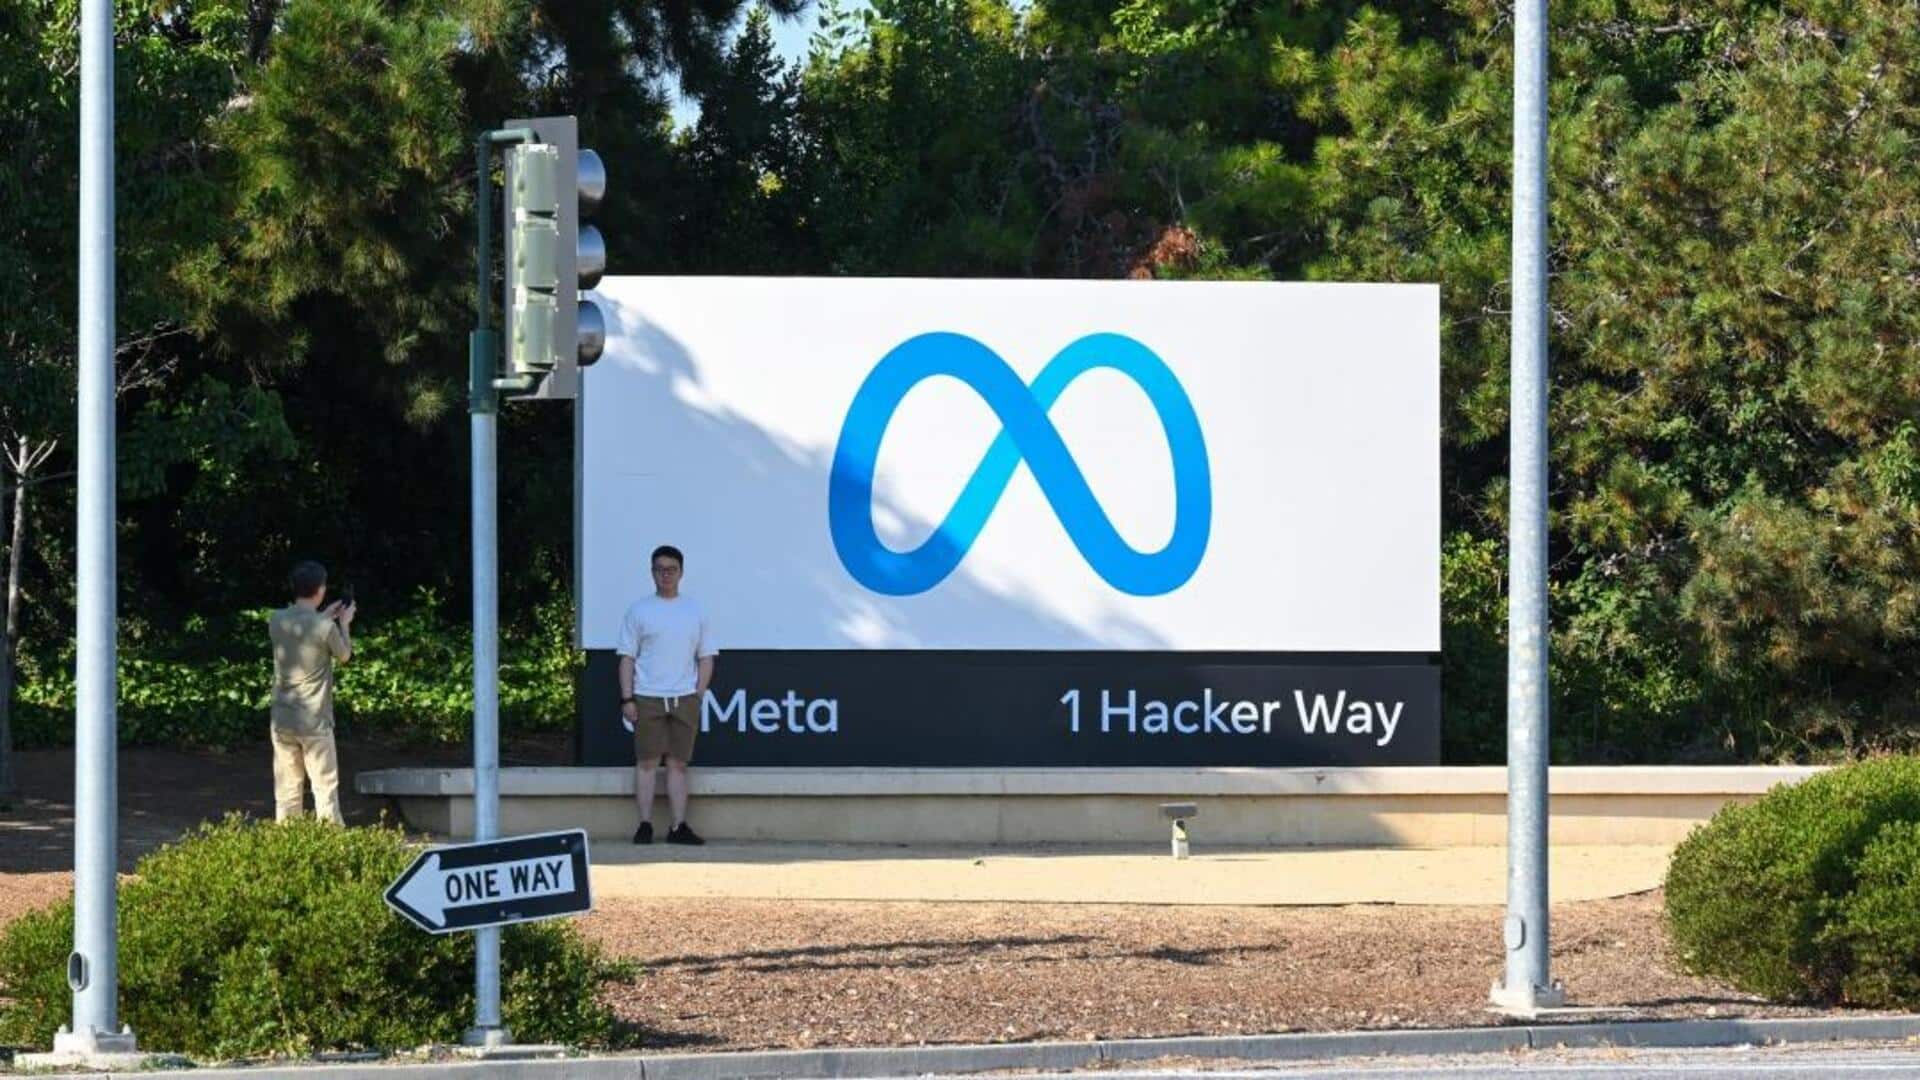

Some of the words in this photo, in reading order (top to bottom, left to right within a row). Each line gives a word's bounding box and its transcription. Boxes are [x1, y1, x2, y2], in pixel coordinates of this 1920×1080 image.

[700, 688, 838, 733] Meta
[1059, 689, 1080, 732] 1
[1101, 688, 1280, 734] Hacker
[1293, 689, 1405, 746] Way
[445, 869, 501, 902] ONE
[510, 860, 564, 894] WAY
